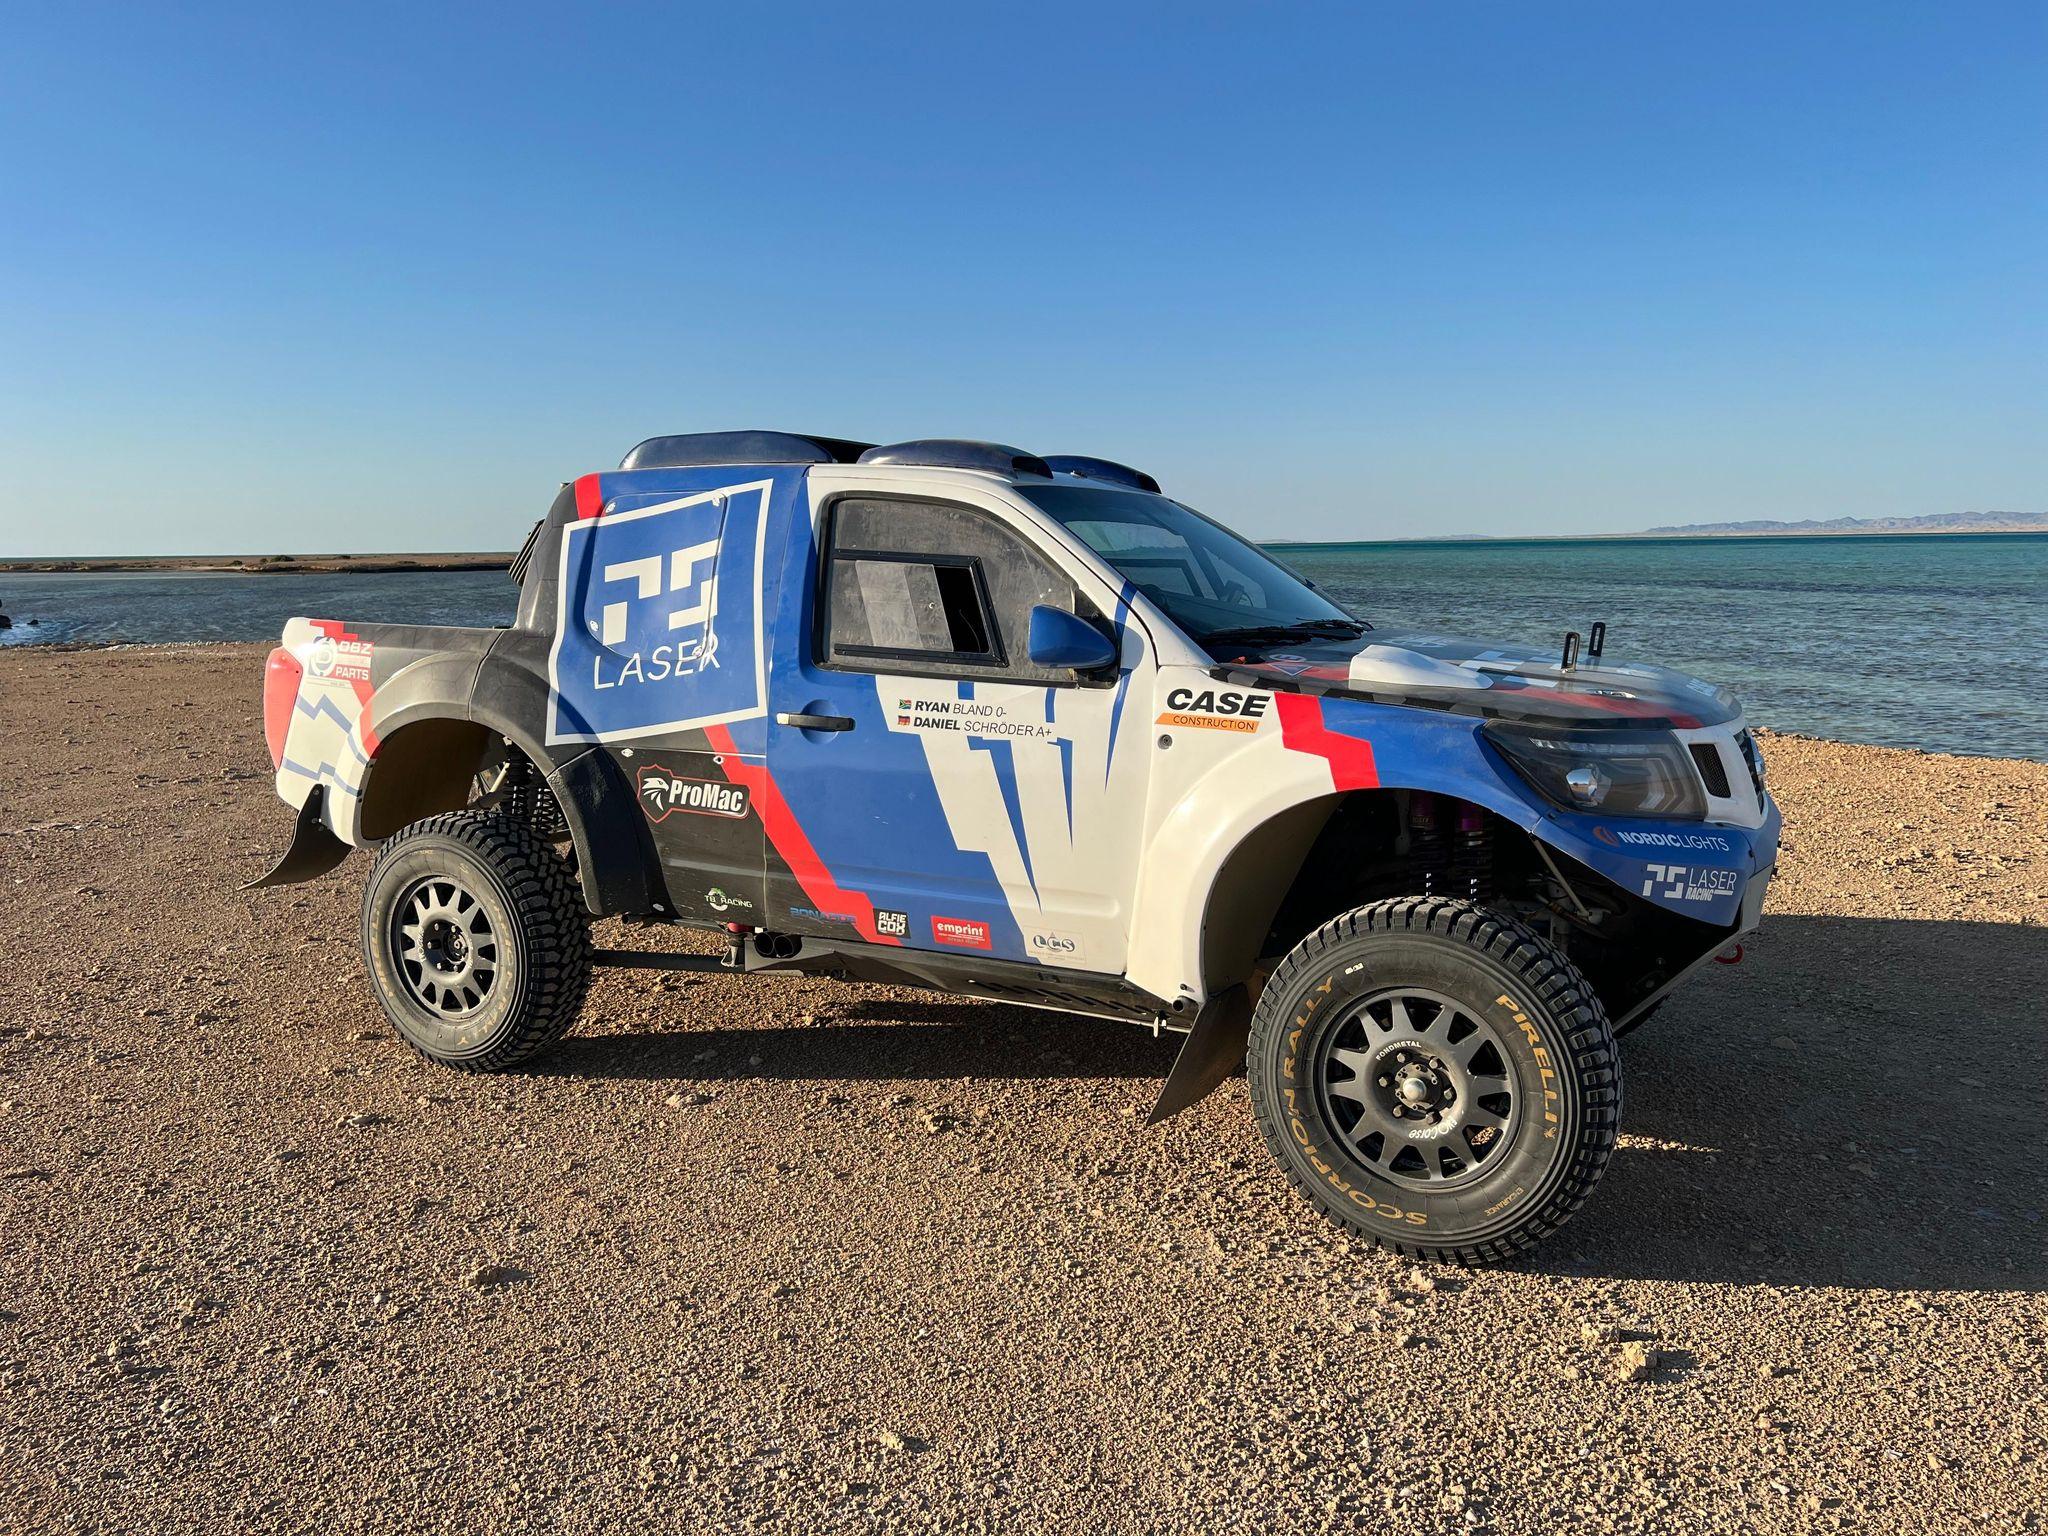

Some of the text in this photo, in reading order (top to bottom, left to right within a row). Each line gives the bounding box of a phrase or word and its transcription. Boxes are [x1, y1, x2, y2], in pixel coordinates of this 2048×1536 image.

[594, 632, 720, 690] LASER
[336, 666, 369, 680] PARTS
[914, 701, 950, 714] RYAN
[953, 703, 993, 716] BLAND
[1167, 688, 1270, 717] CASE
[914, 717, 1052, 738] DANIEL SCHRÖDER A+
[1173, 715, 1255, 731] CONSTRUCTION
[669, 780, 743, 811] ProMac
[1688, 867, 1737, 890] LASER
[720, 897, 752, 908] RACING
[1685, 886, 1714, 901] RACING
[879, 911, 907, 923] ALFIE
[878, 920, 906, 936] COX
[937, 922, 984, 936] emprint
[1376, 1040, 1422, 1061] FONDMETAL
[1495, 994, 1557, 1123] PIRELLI
[1283, 975, 1428, 1225] SCORPION RALLY
